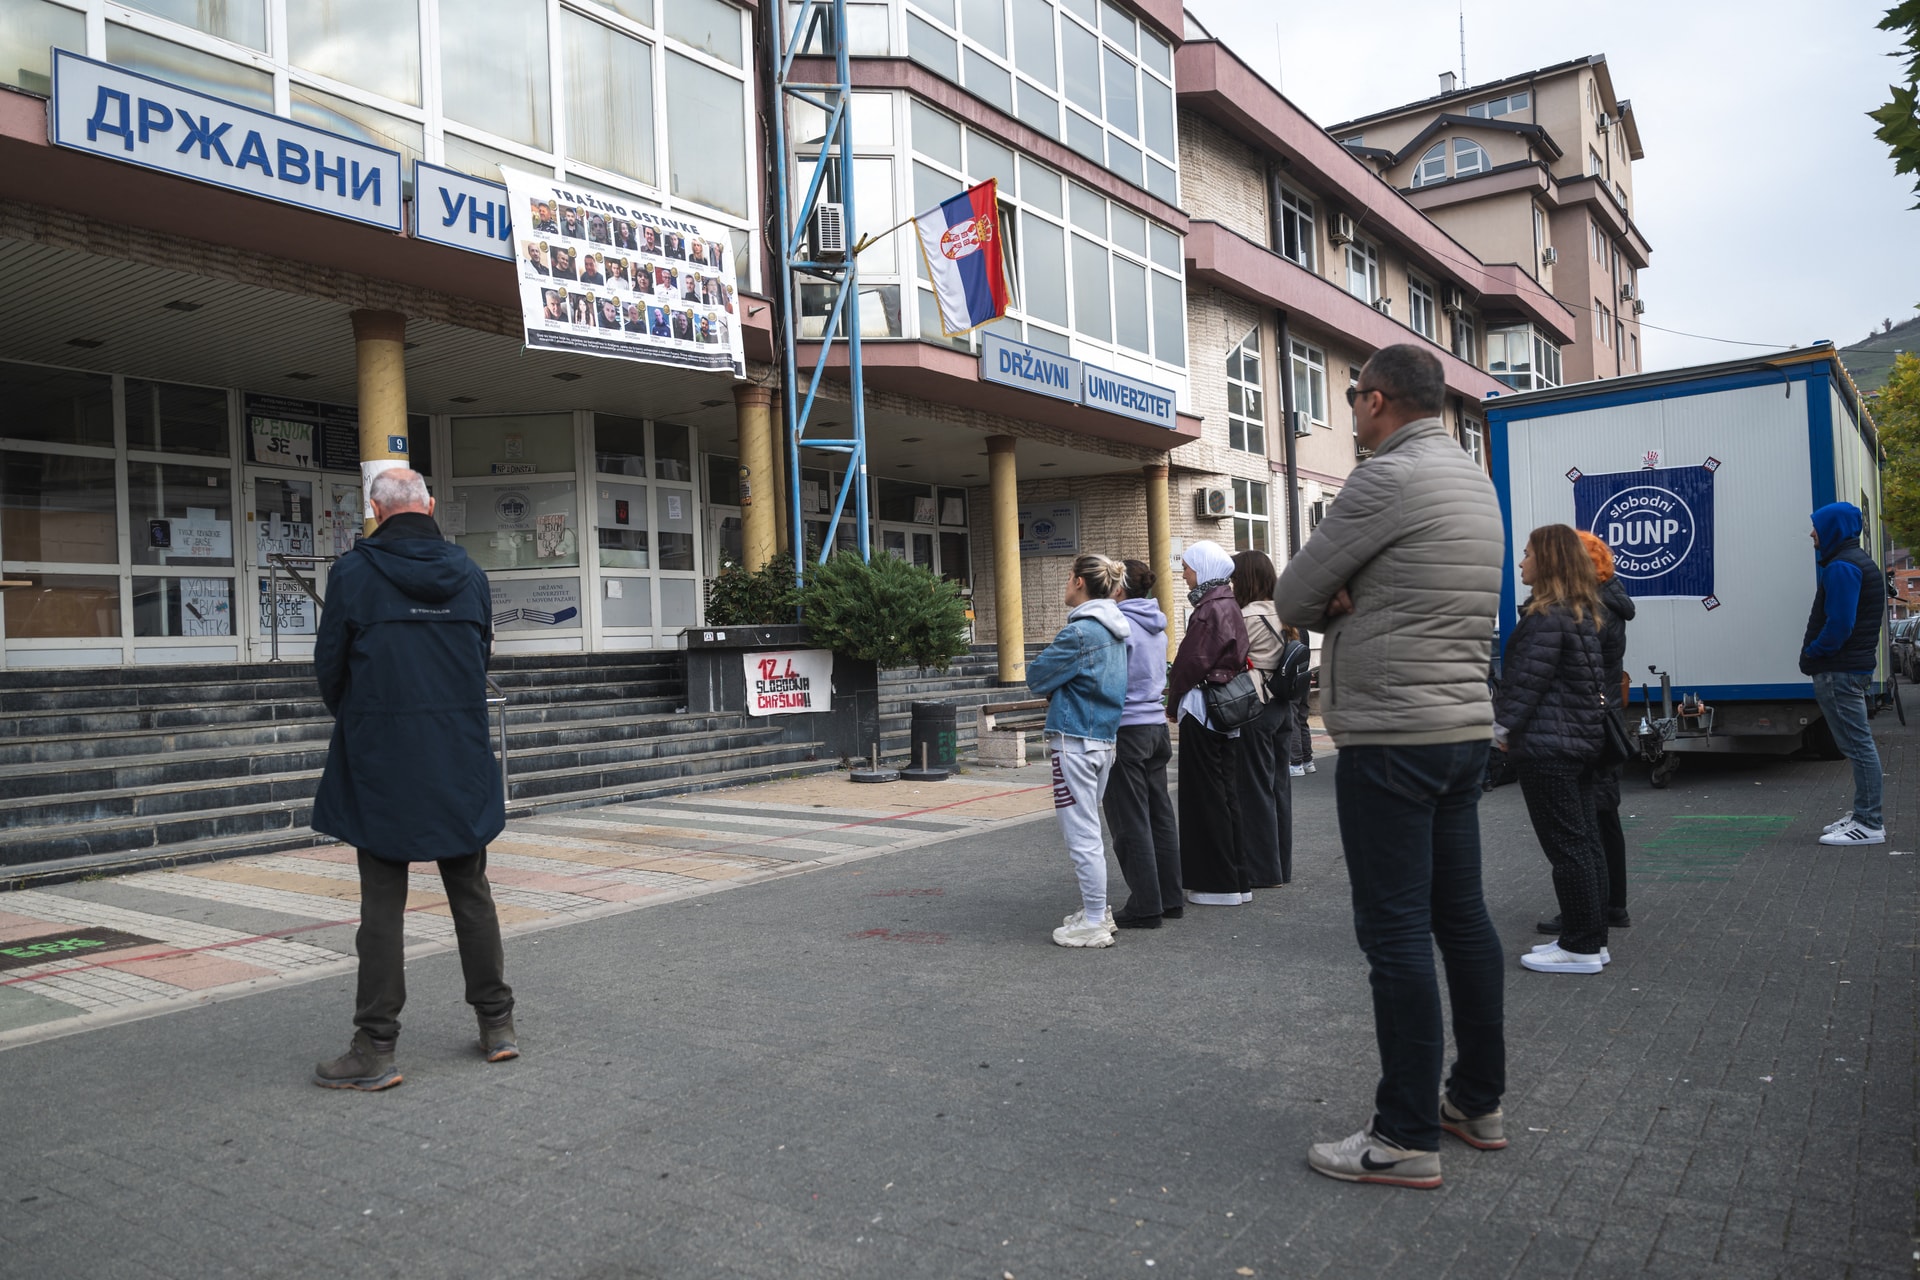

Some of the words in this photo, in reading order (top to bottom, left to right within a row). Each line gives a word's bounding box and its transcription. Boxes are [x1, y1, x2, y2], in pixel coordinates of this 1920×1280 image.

[86, 84, 382, 207] ДРЖАВНИ
[551, 187, 628, 217] TRAŽIMO
[631, 209, 700, 235] OSTAVKE
[999, 349, 1069, 390] DRŽAVNI
[1088, 374, 1171, 419] UNIVERZITET
[253, 417, 310, 442] PLENUM
[266, 436, 291, 455] SE
[396, 438, 403, 450] 9
[1609, 495, 1676, 519] slobodni
[1608, 519, 1679, 547] DUNP
[1611, 550, 1677, 572] slobodni
[277, 602, 302, 617] SEBE
[755, 677, 810, 694] SLOBODNA
